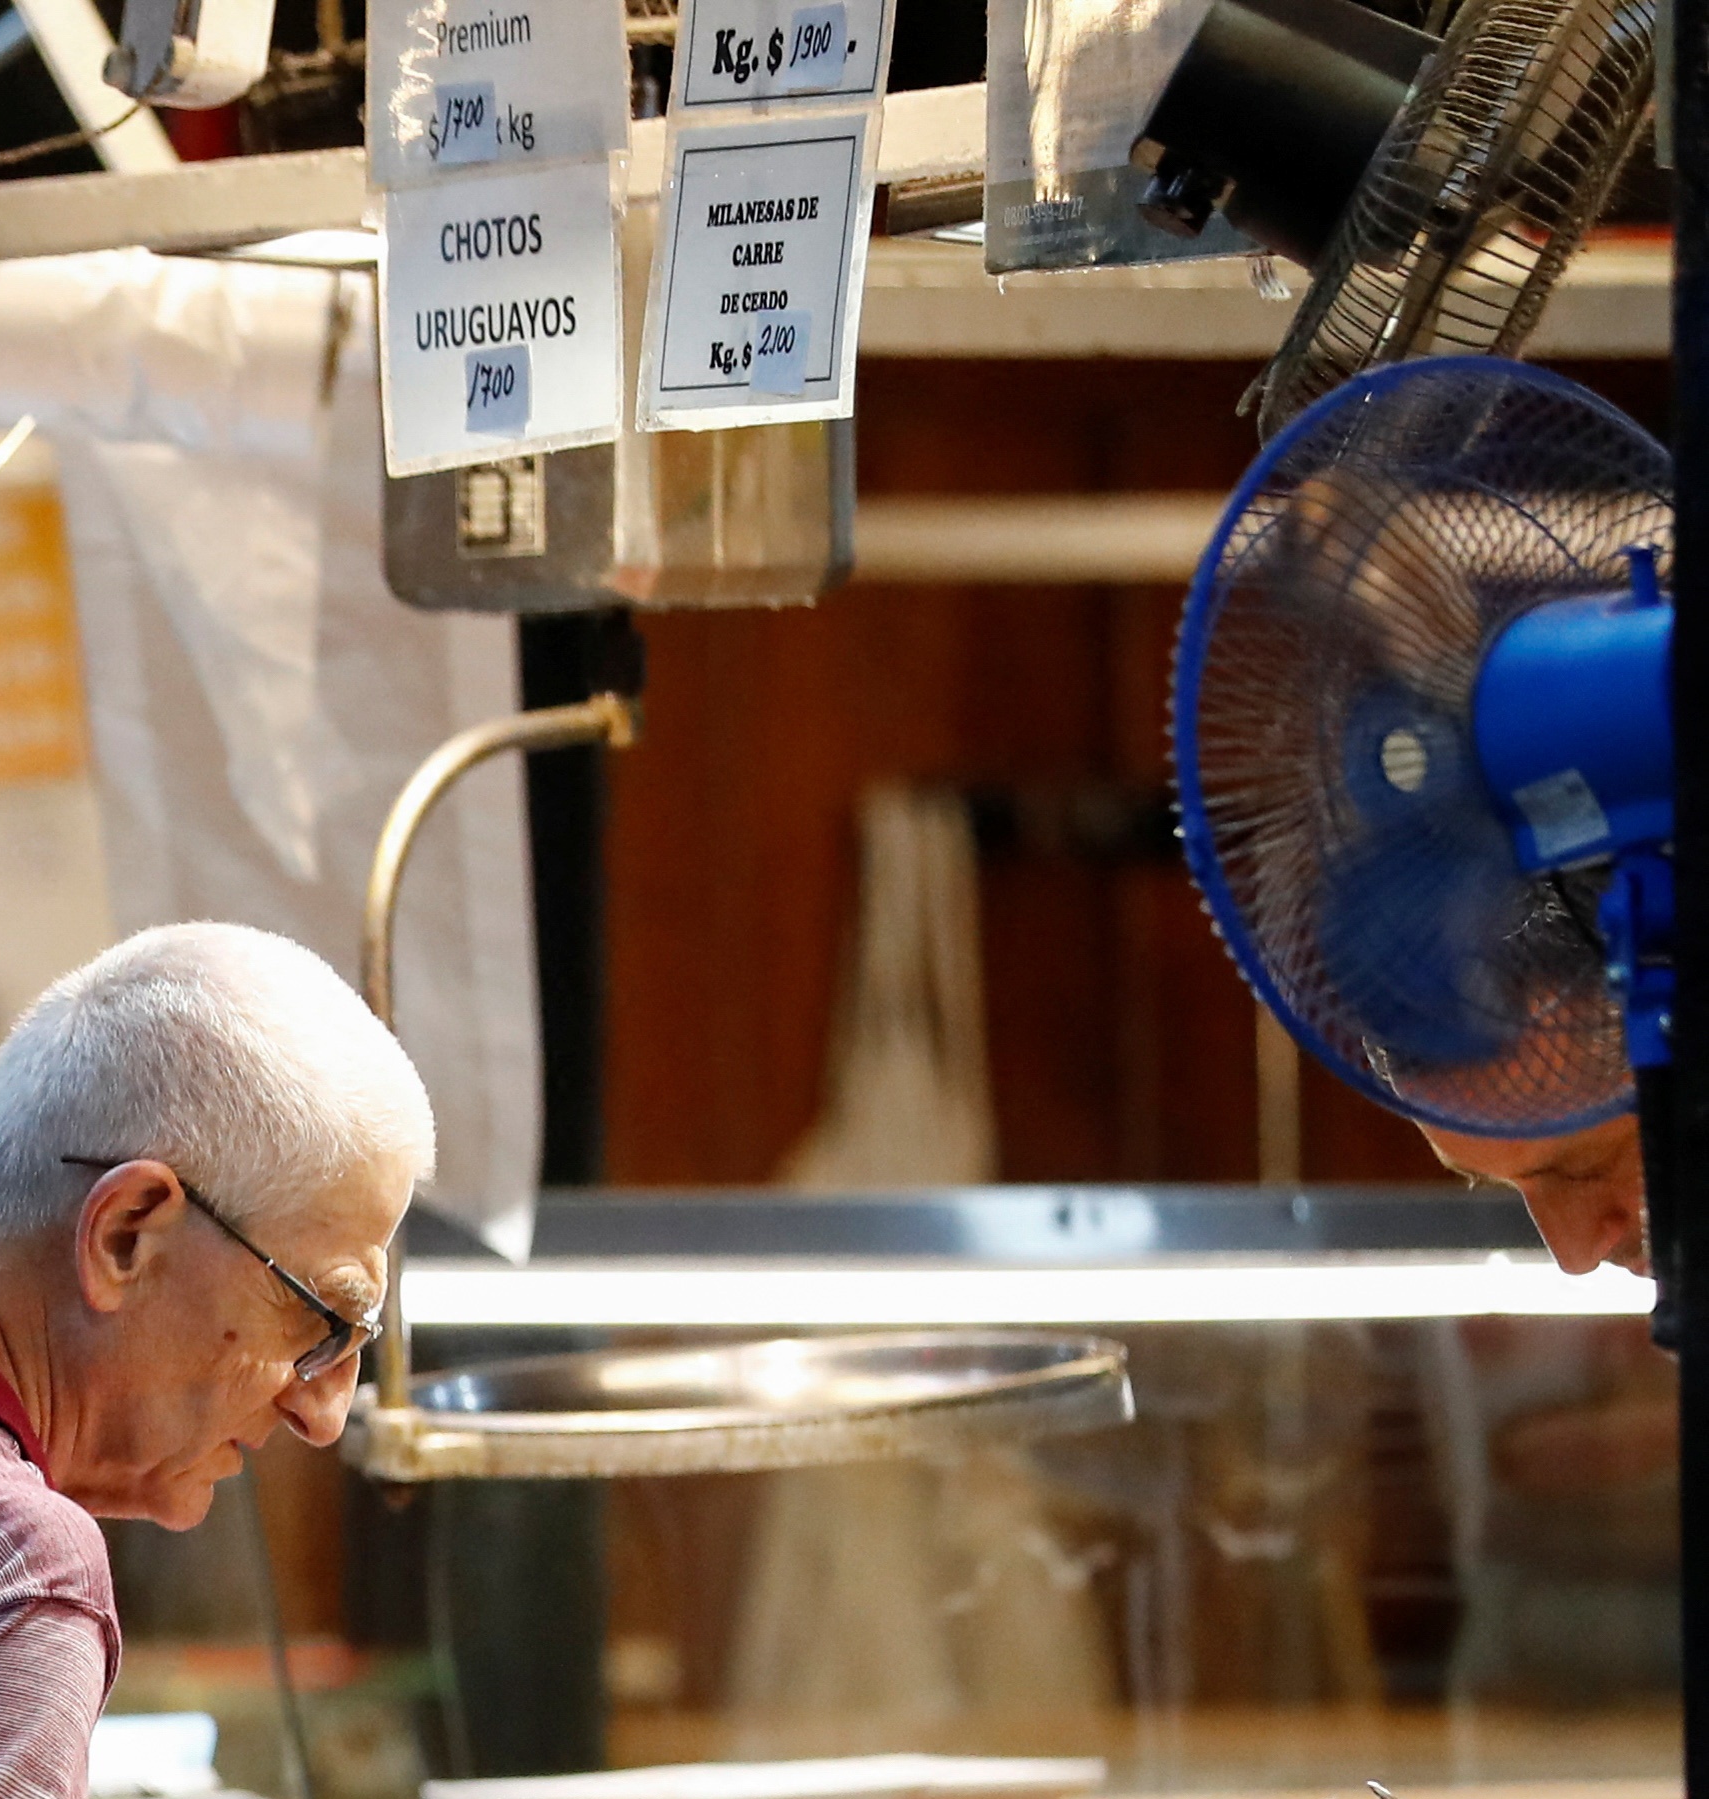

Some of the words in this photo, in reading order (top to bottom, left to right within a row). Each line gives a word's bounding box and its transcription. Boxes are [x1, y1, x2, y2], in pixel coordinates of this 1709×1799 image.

[436, 9, 532, 58] Premium
[712, 28, 759, 84] Kg.
[706, 198, 795, 228] MILANESAS
[796, 195, 820, 221] DE
[440, 214, 543, 264] CHOTOS
[731, 241, 785, 267] CARRE
[416, 295, 577, 351] URUGUAYOS
[719, 293, 740, 314] DE
[741, 289, 789, 313] CERDO
[708, 341, 738, 375] Kg.
[467, 360, 515, 409] 1700
